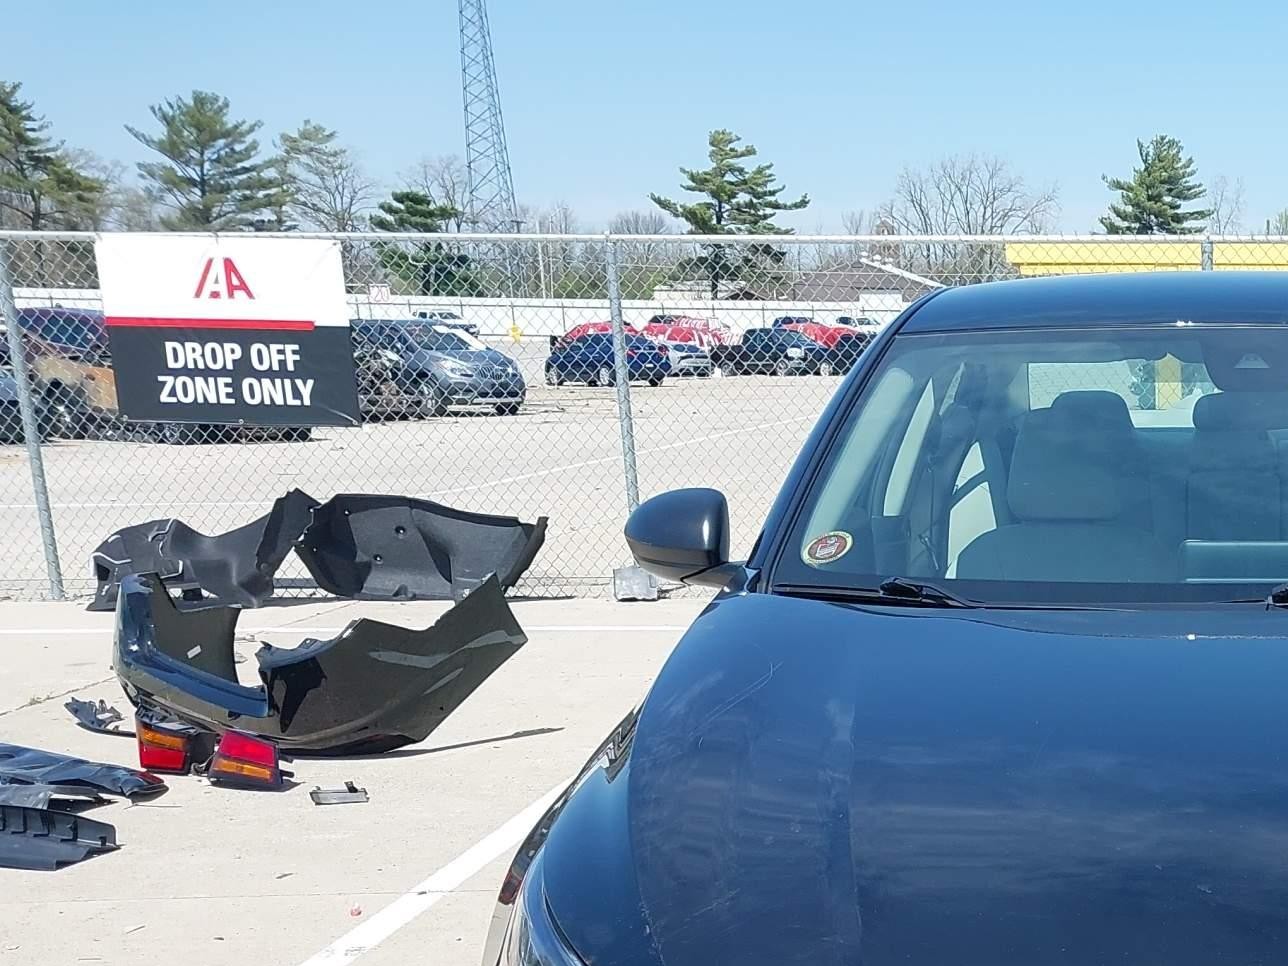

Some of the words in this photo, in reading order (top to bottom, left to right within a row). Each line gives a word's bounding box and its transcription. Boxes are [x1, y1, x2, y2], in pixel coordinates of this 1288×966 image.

[164, 341, 242, 370] DROP
[250, 343, 301, 371] OFF
[157, 375, 236, 404] ZONE
[241, 377, 314, 406] ONLY
